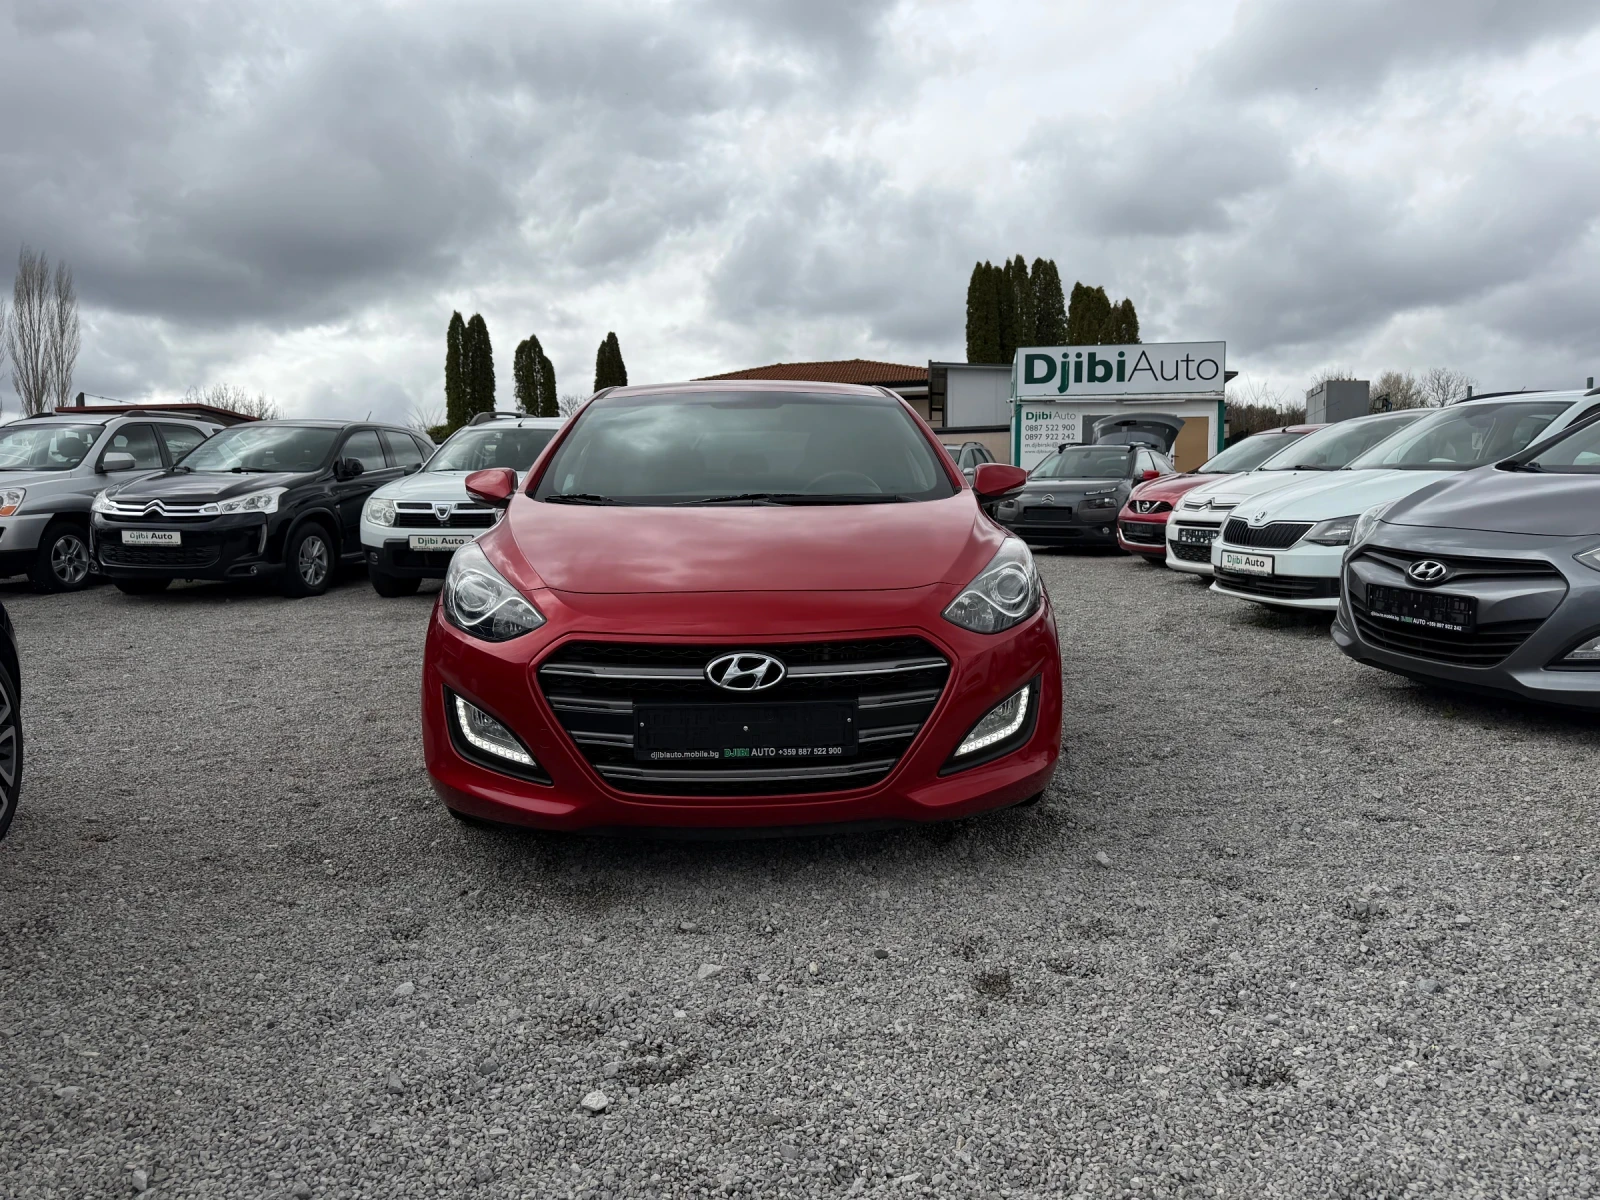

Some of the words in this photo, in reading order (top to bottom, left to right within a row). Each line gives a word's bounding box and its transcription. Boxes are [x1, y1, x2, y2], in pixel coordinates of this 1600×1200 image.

[418, 537, 438, 546] Djibi
[1227, 554, 1243, 566] Djibi
[1244, 557, 1265, 568] Auto
[650, 750, 719, 759] djibiauto.mobile.bg
[724, 748, 750, 757] DJIBI
[751, 748, 776, 756] AUTO
